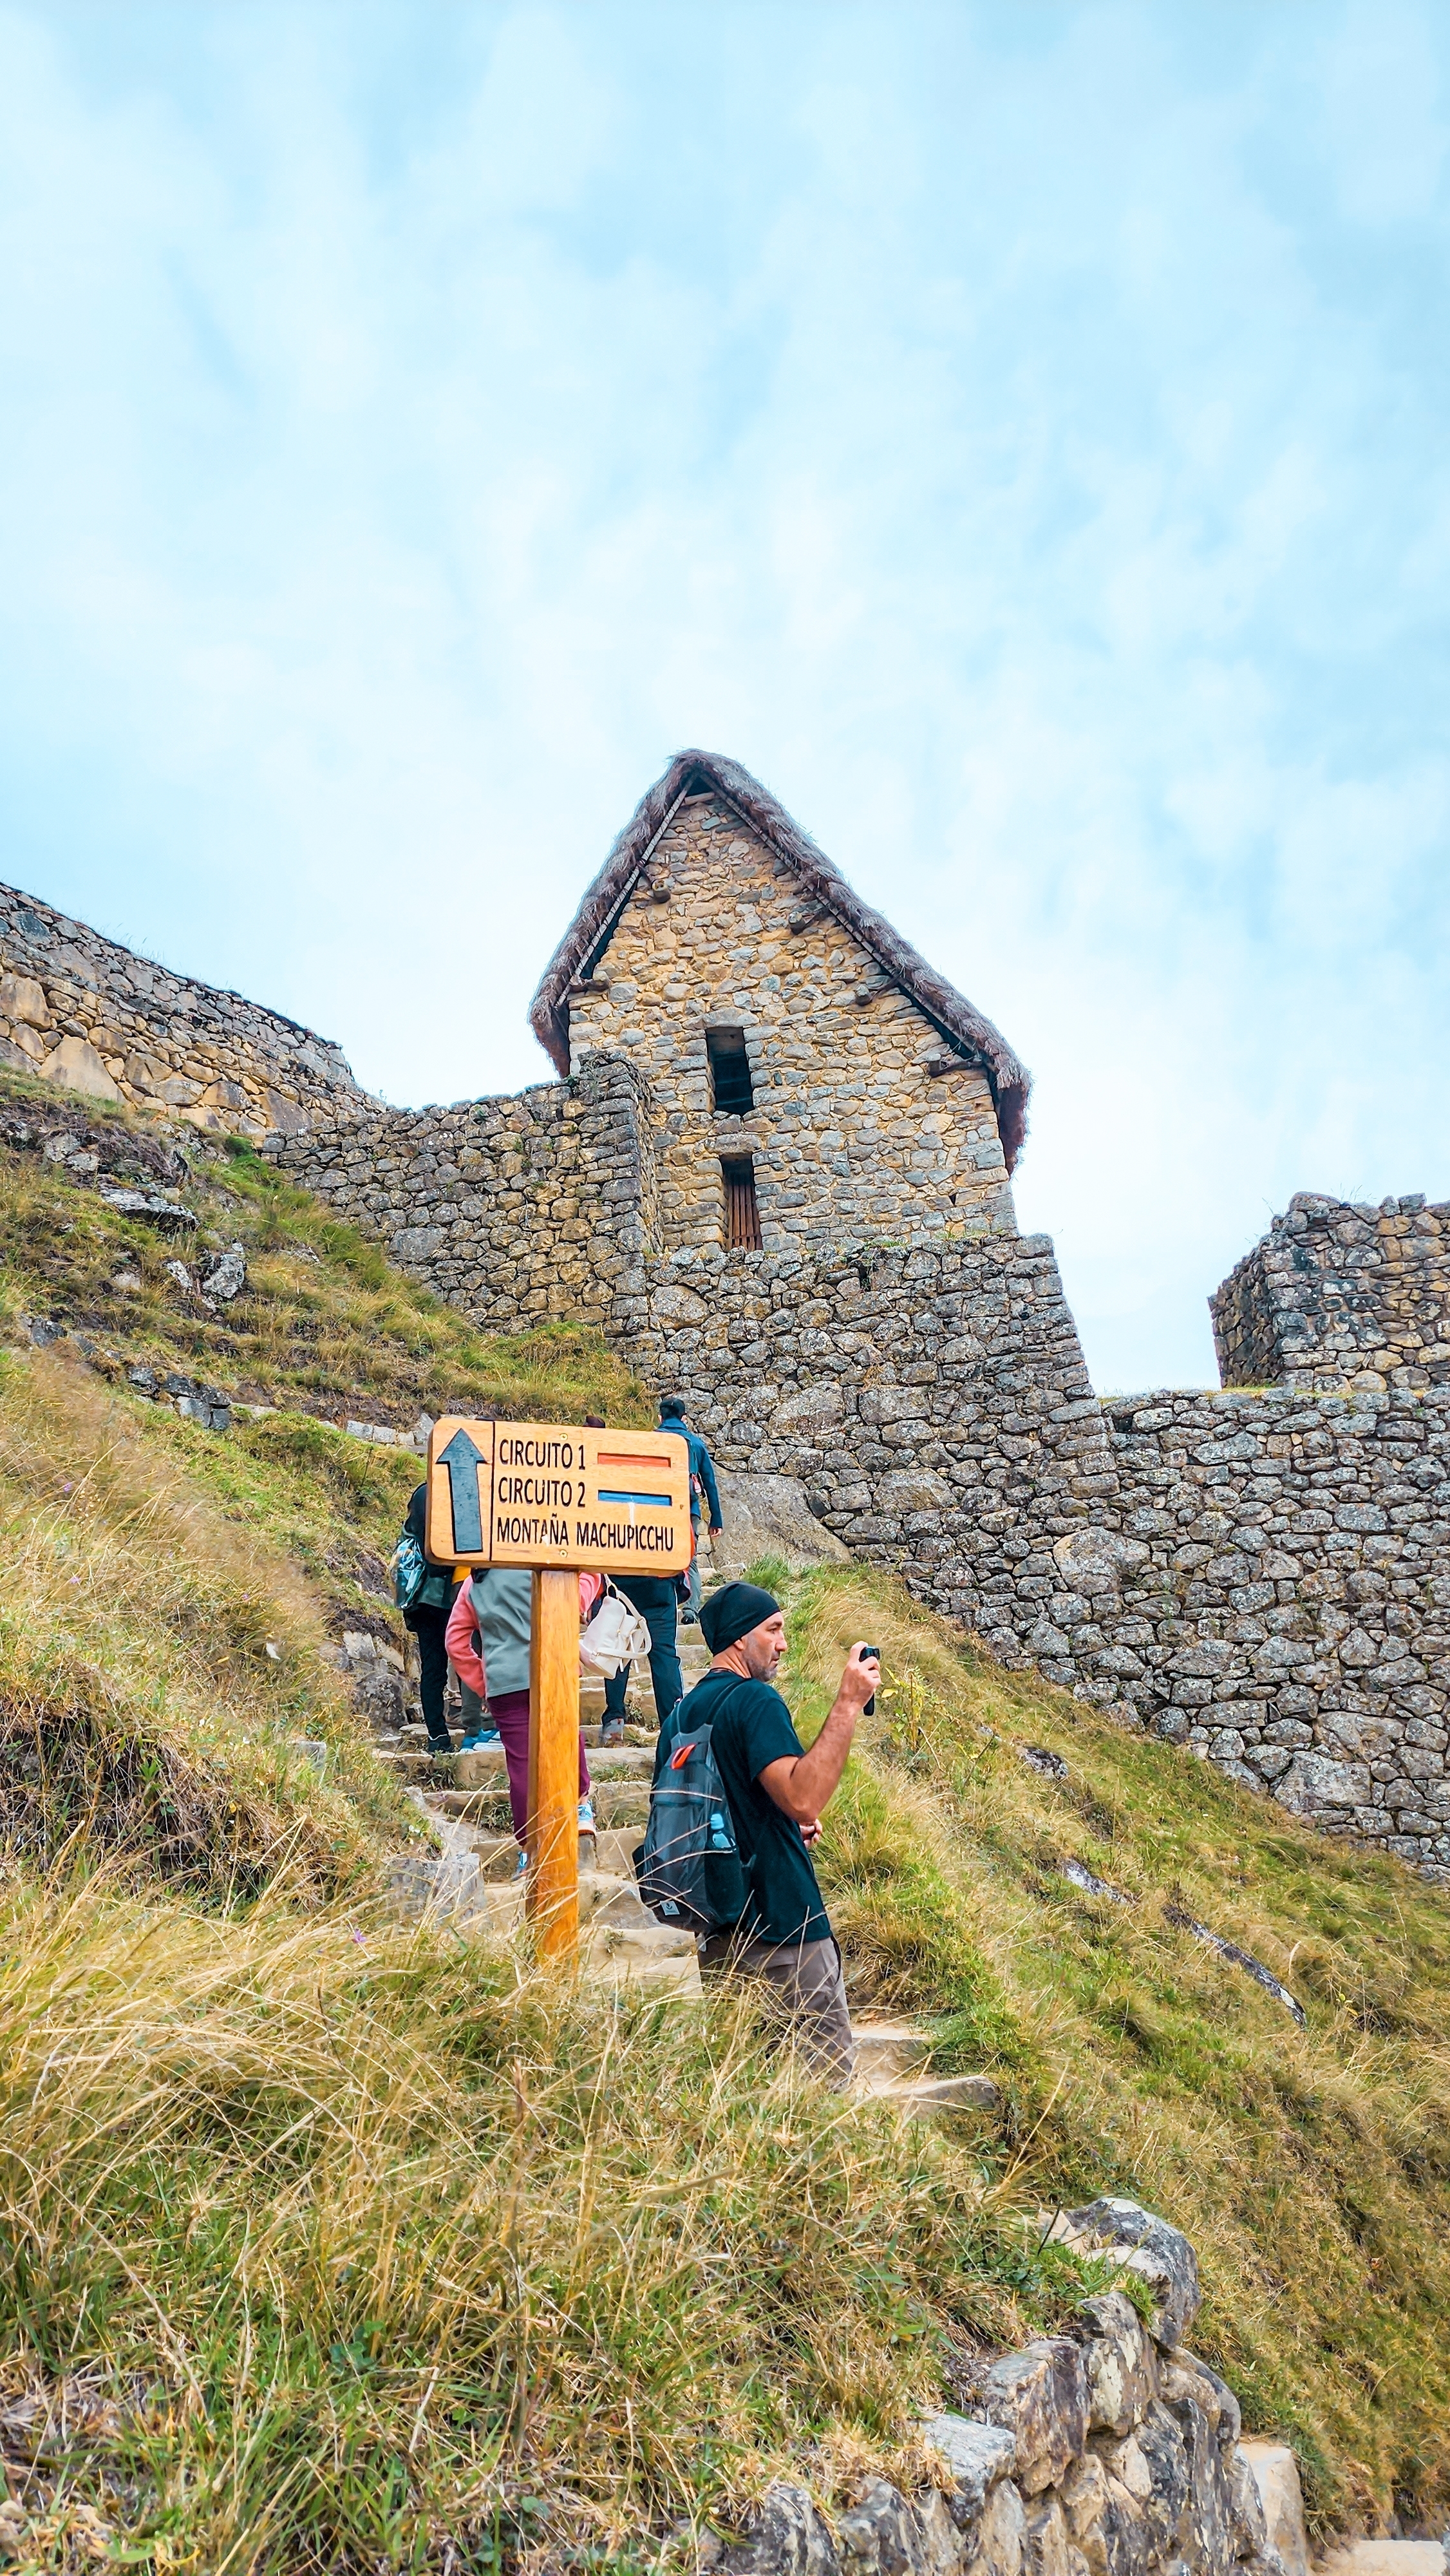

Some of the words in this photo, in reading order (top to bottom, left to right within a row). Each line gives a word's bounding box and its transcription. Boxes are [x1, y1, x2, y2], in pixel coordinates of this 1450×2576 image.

[500, 1439, 572, 1469] CIRCUITO
[579, 1444, 585, 1470] 1
[498, 1477, 572, 1507] CIRCUITO
[578, 1482, 585, 1507] 2
[497, 1513, 569, 1545] MONTAÑA
[577, 1521, 673, 1551] MACHUPICCHU
